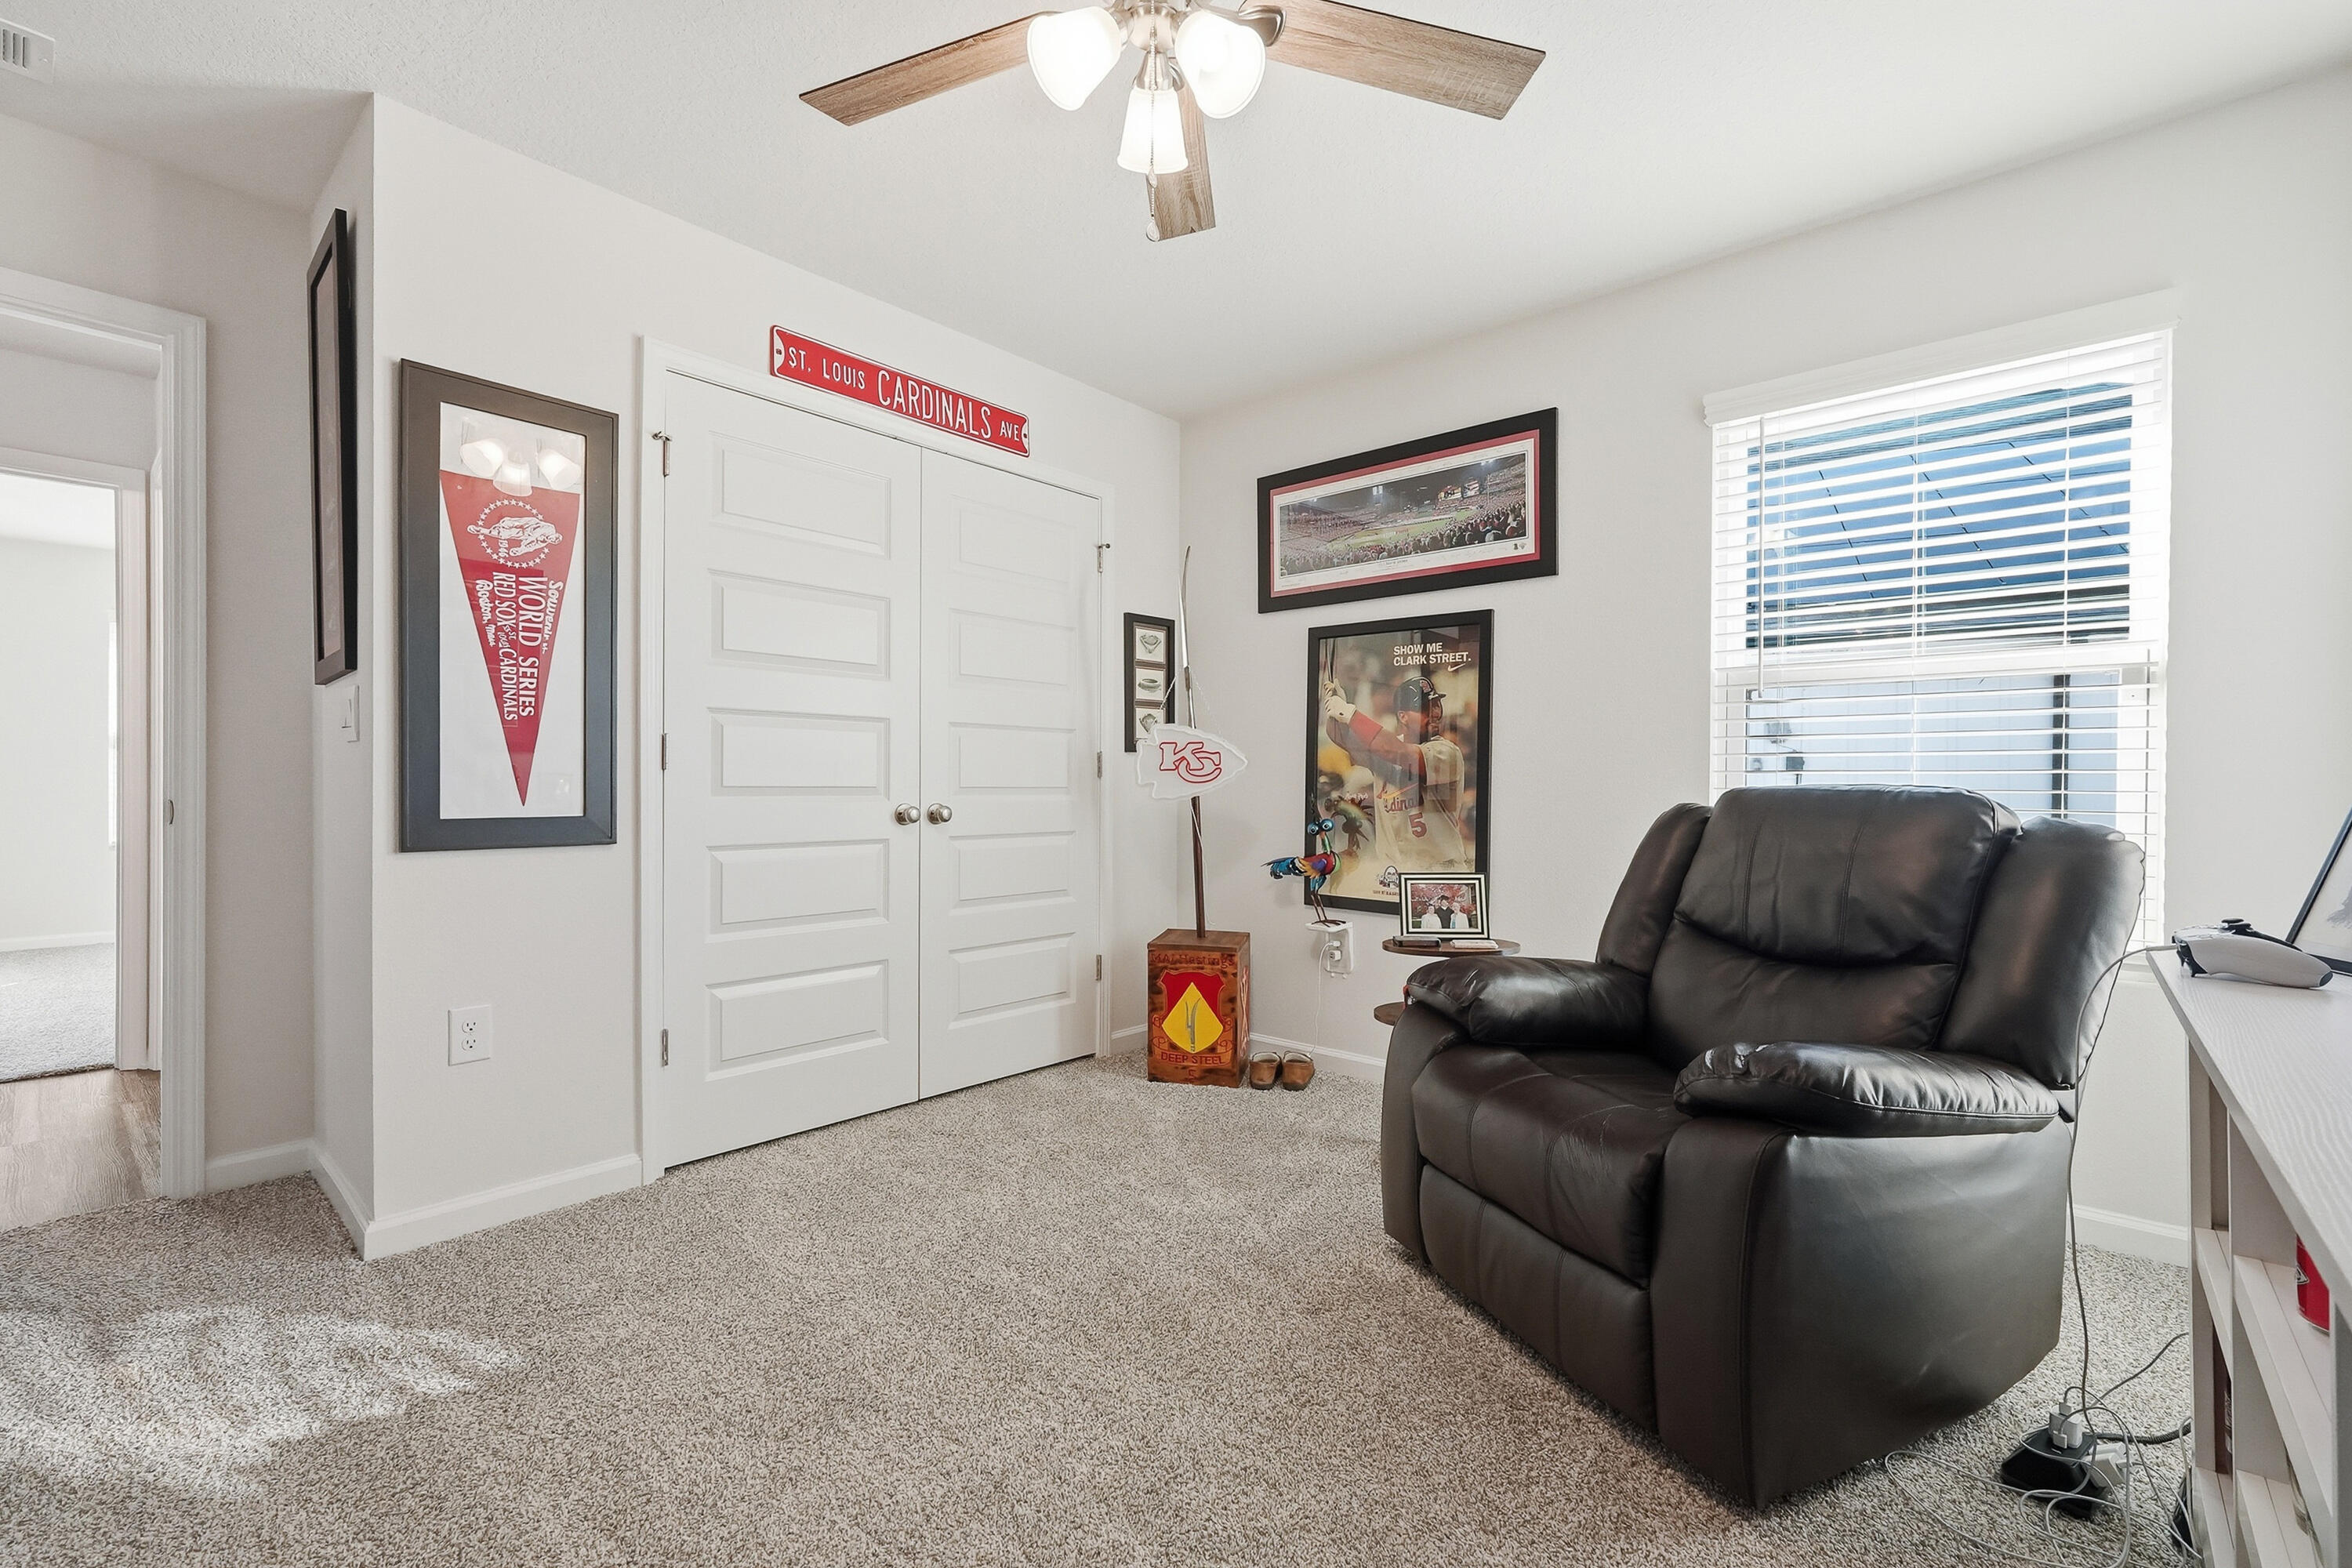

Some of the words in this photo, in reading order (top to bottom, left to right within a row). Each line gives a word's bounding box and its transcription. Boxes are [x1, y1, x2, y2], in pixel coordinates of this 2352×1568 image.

[822, 358, 866, 390] LOUIS
[877, 369, 993, 439] CARDINALS
[1000, 419, 1020, 441] AVE
[492, 572, 516, 597] RED
[495, 600, 517, 627] SOX
[518, 576, 548, 647] WORLD
[543, 580, 564, 640] Souvenir
[1393, 644, 1424, 655] SHOW
[1426, 643, 1443, 652] ME
[1393, 655, 1427, 666] CLARK
[1429, 652, 1472, 663] STREET.
[499, 648, 517, 720] CARDINALS
[518, 656, 539, 717] SERIES
[1409, 811, 1427, 838] 5
[1161, 1051, 1188, 1063] DEEP
[1192, 1055, 1225, 1065] STEEL
